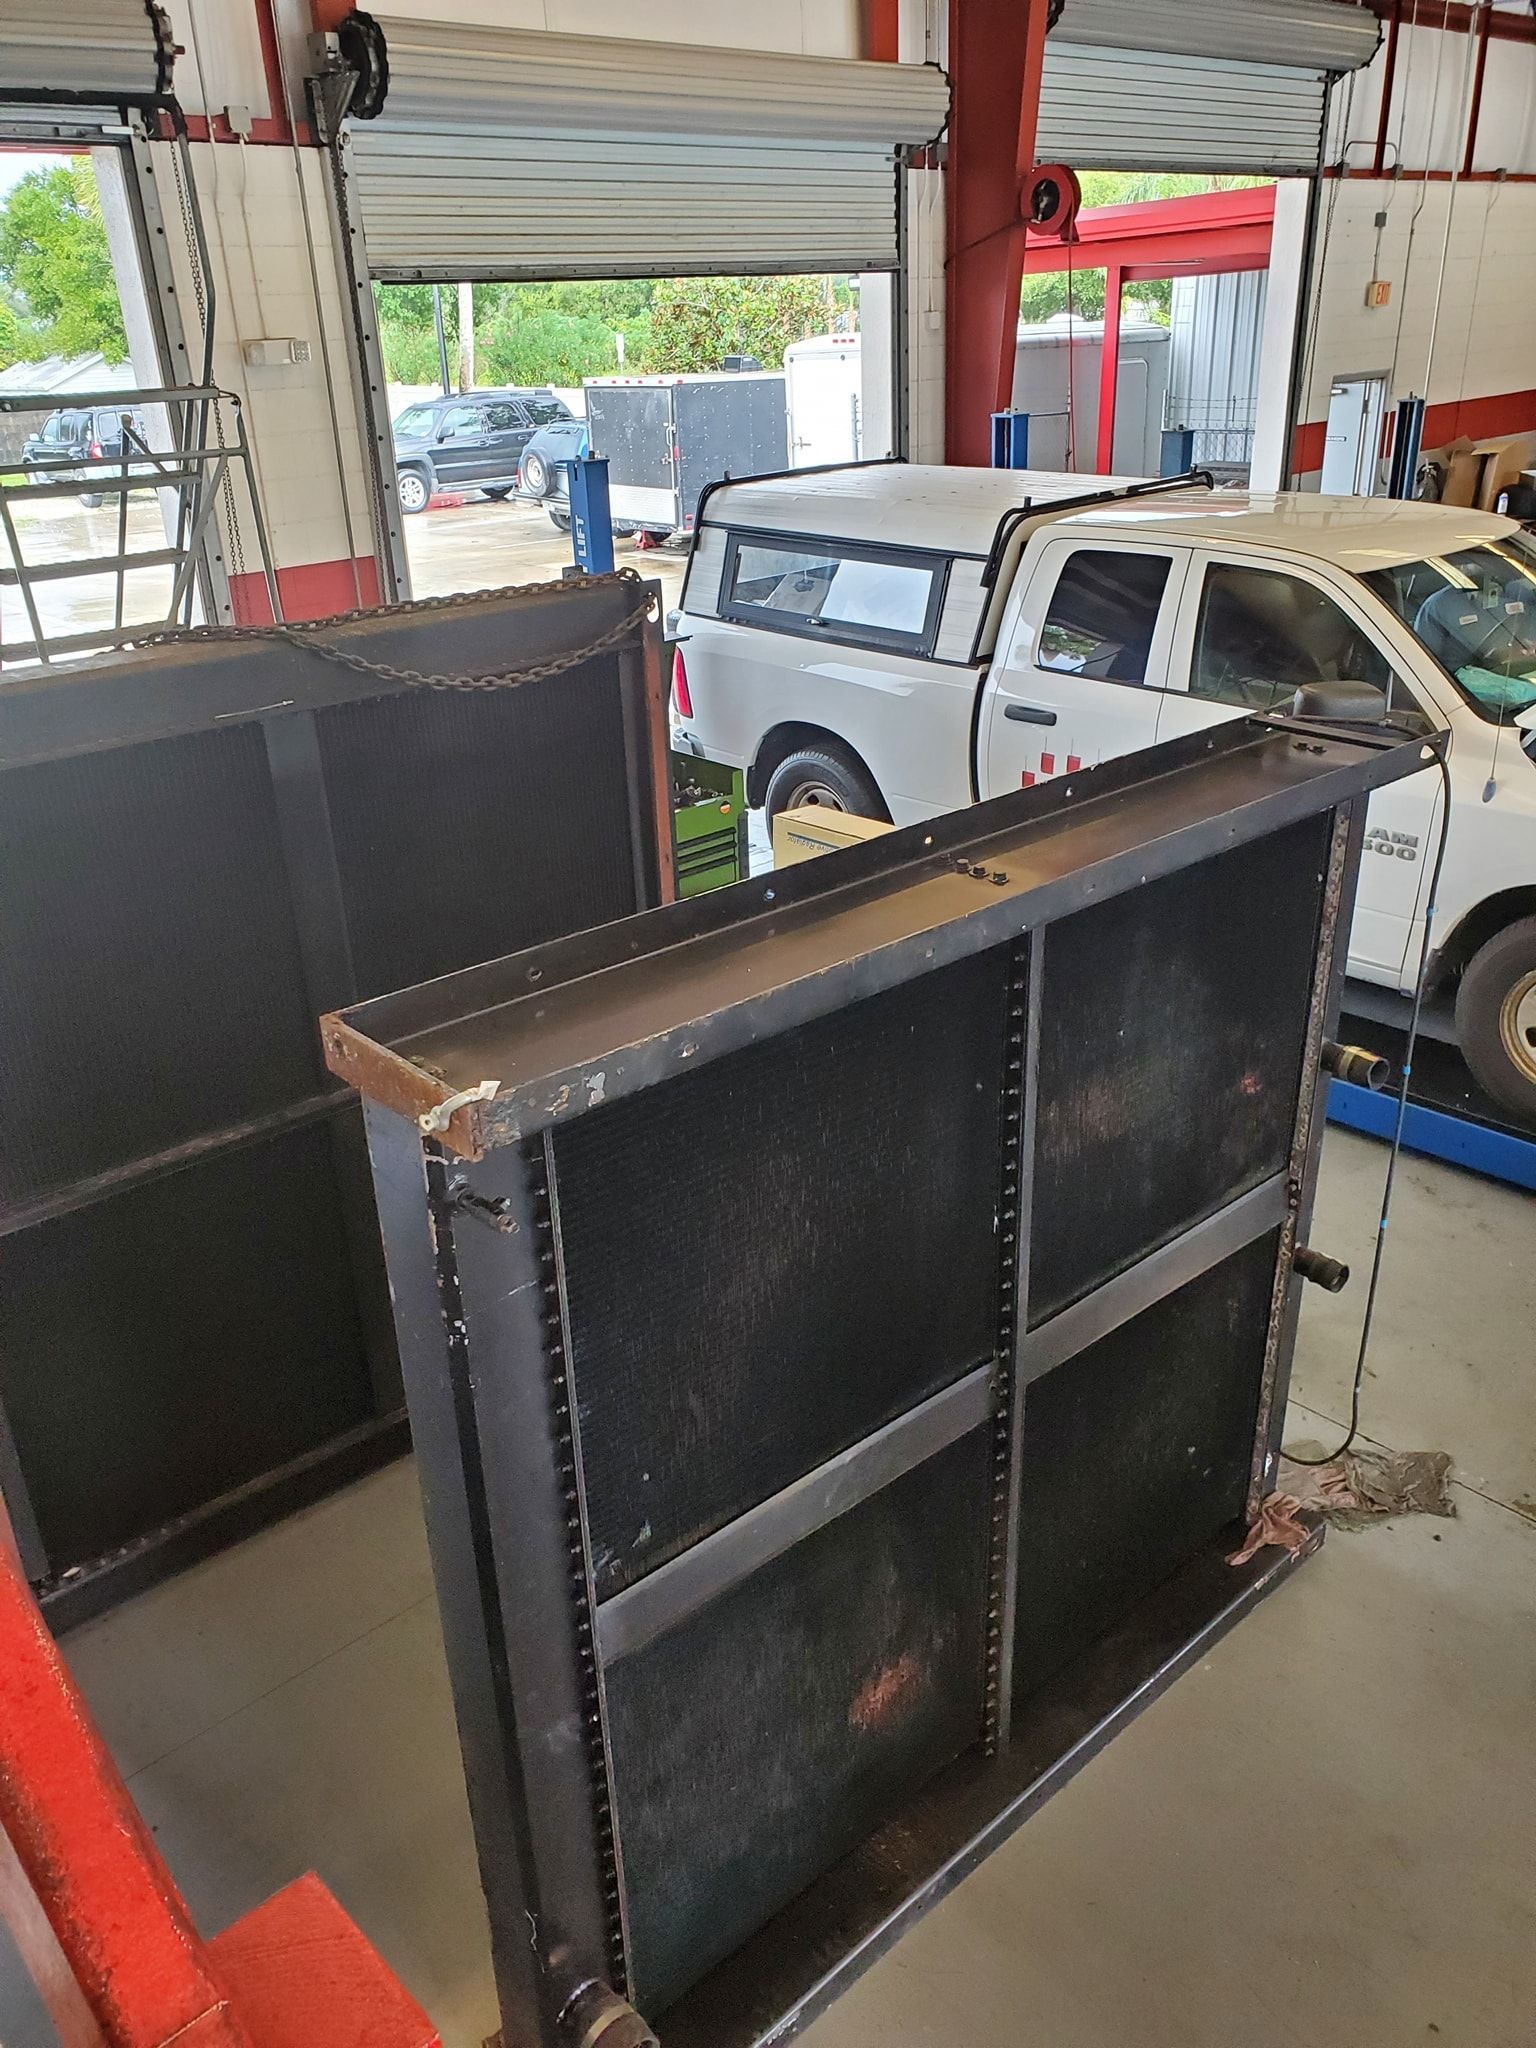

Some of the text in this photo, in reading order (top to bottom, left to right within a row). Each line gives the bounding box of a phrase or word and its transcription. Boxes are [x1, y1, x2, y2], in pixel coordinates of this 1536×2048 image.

[575, 515, 587, 557] LIFT
[787, 836, 815, 851] Radiator
[1367, 826, 1419, 848] AM
